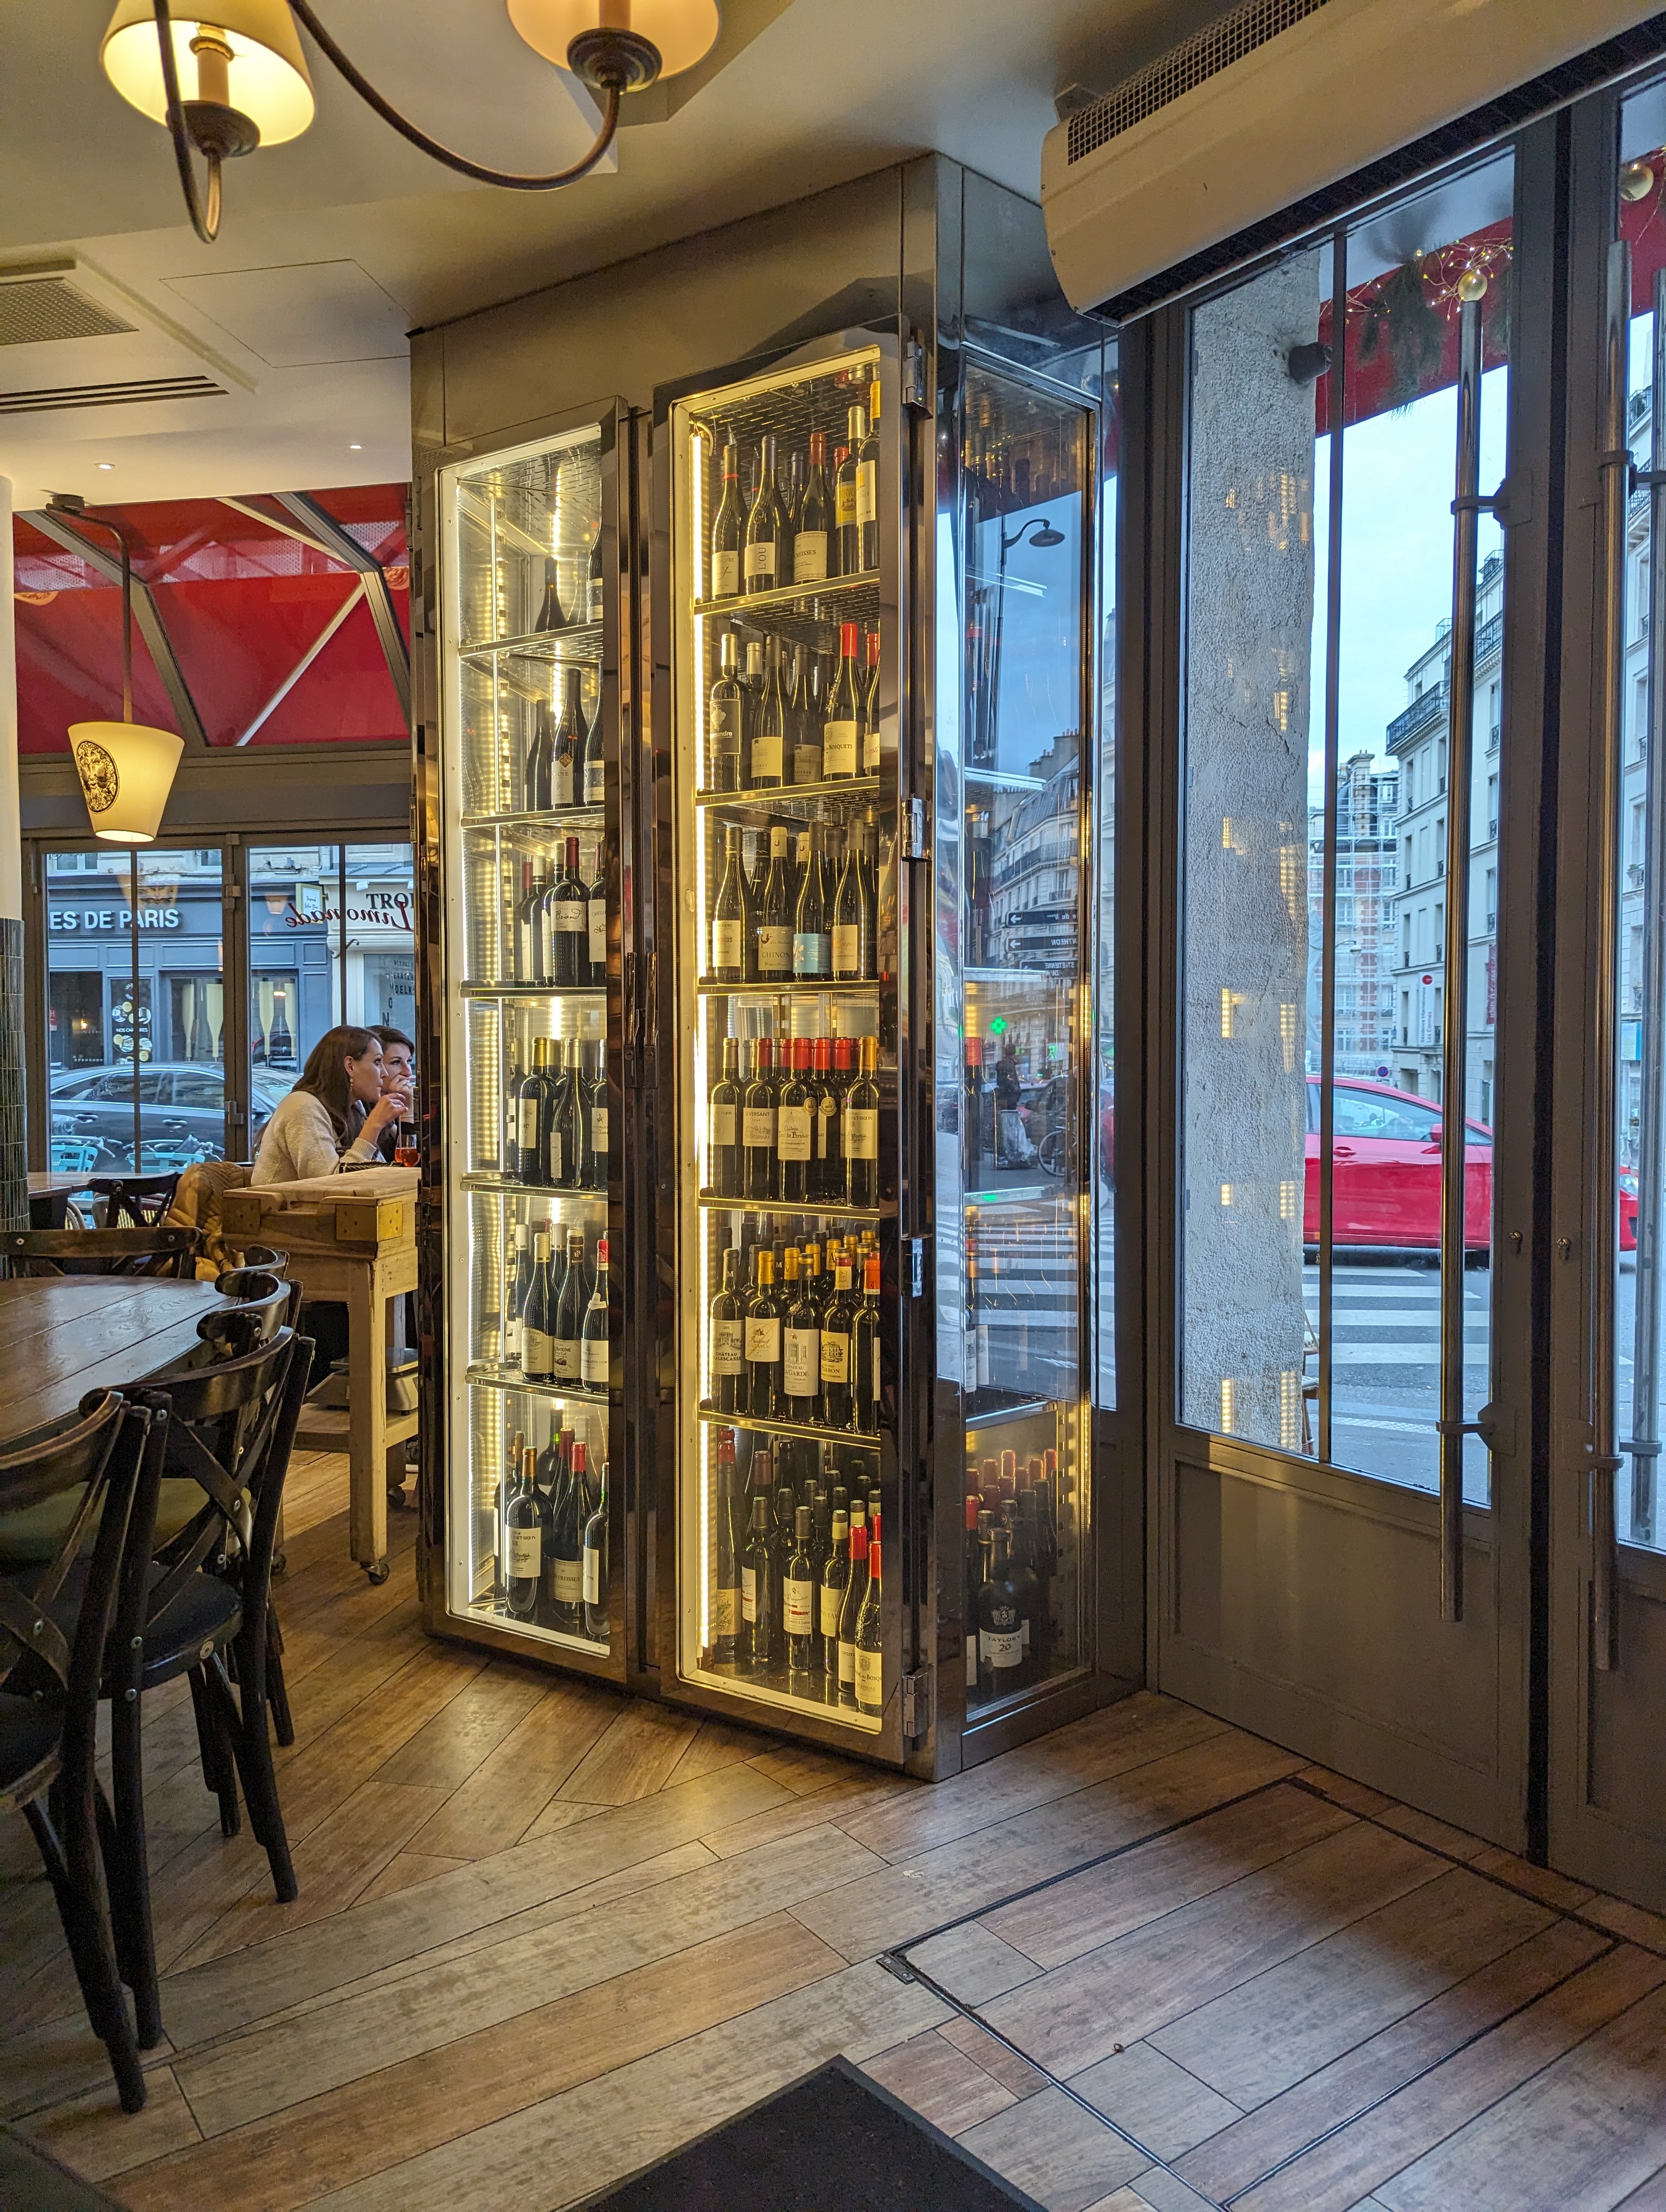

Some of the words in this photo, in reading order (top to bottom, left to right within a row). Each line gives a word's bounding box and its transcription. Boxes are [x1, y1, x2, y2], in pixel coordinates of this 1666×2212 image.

[758, 547, 766, 570] L'OU
[366, 892, 414, 910] TRO
[85, 911, 112, 929] DE
[998, 1643, 1011, 1652] 20
